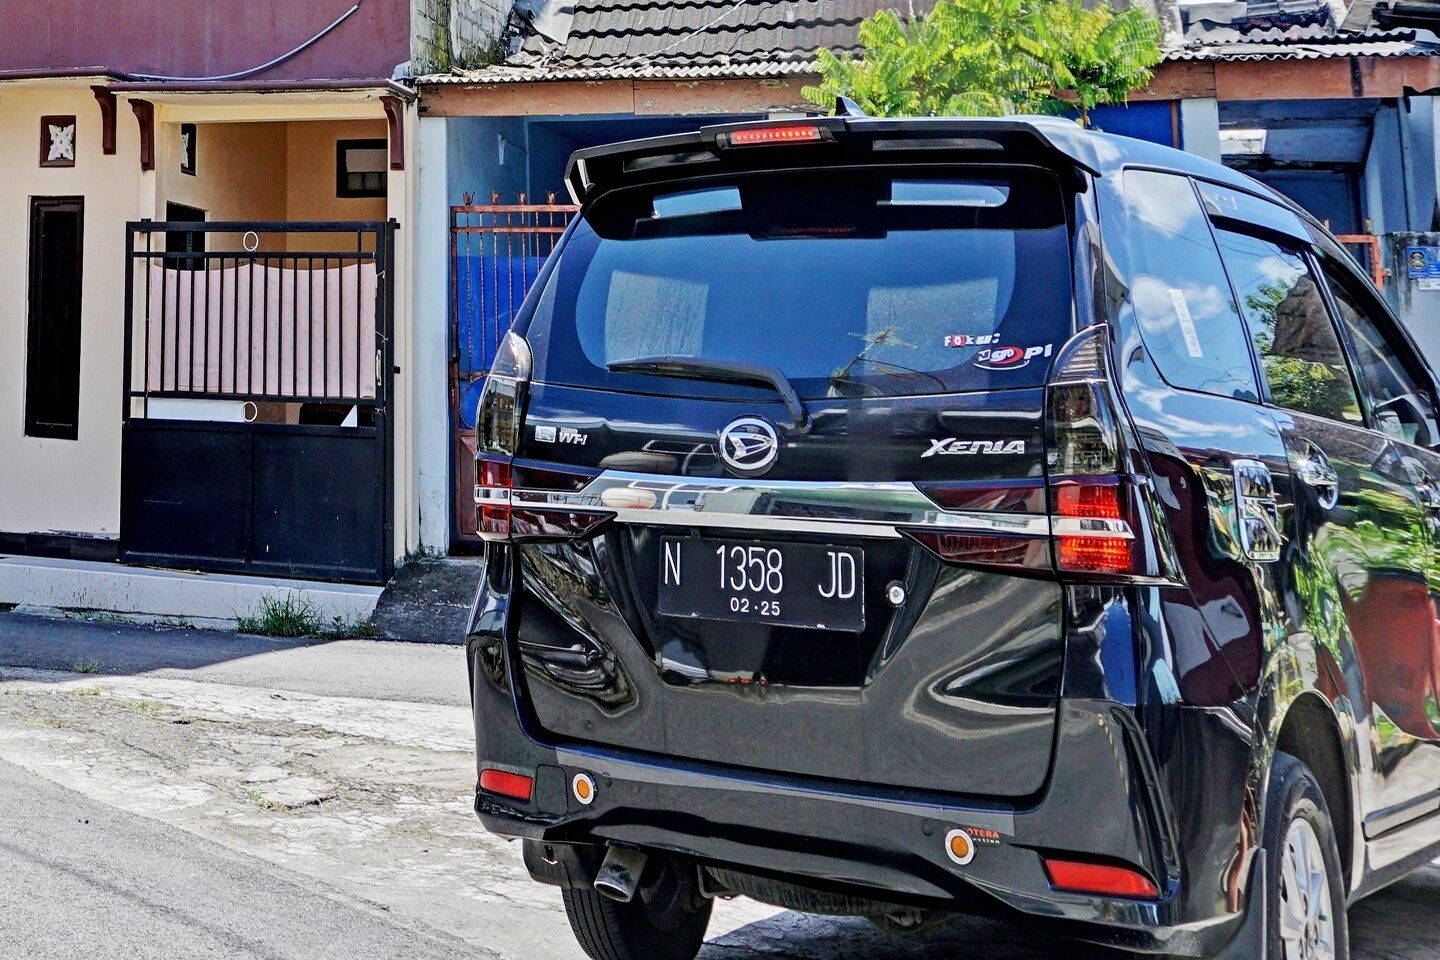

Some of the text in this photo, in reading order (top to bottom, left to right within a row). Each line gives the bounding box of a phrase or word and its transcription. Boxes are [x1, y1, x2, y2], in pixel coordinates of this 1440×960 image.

[664, 541, 855, 599] N 1358 JD
